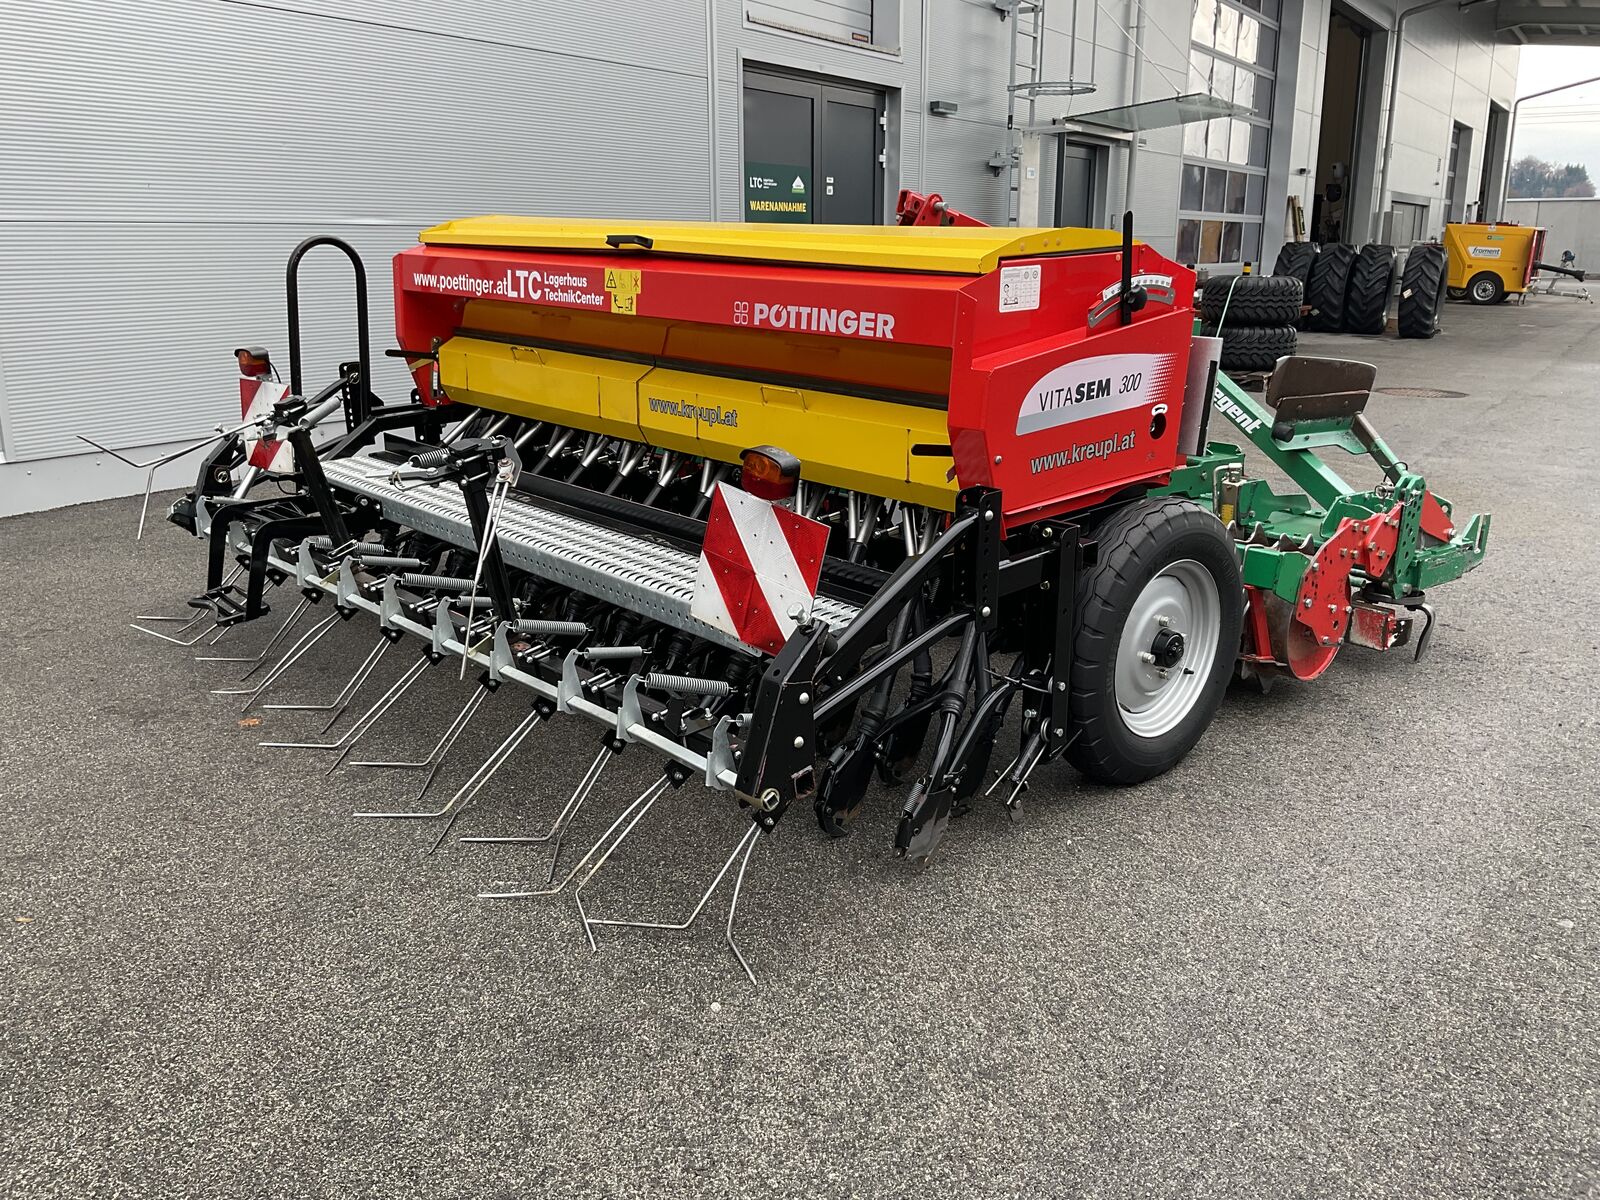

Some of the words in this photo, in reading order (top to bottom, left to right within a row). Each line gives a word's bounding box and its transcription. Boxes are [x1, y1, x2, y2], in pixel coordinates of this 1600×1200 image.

[749, 176, 763, 189] LTC
[749, 200, 807, 213] WARENANNAHME
[1472, 246, 1500, 255] froment
[413, 272, 508, 296] www.poettinger.at
[507, 269, 542, 300] LTC
[544, 271, 588, 288] Lagerhaus
[544, 288, 604, 306] TechnikCenter
[1039, 377, 1112, 412] VITASEM
[1119, 372, 1142, 394] 300
[648, 397, 738, 428] www.kreupl.at
[1213, 381, 1263, 434] egent
[1030, 430, 1137, 475] www.kreupl.at
